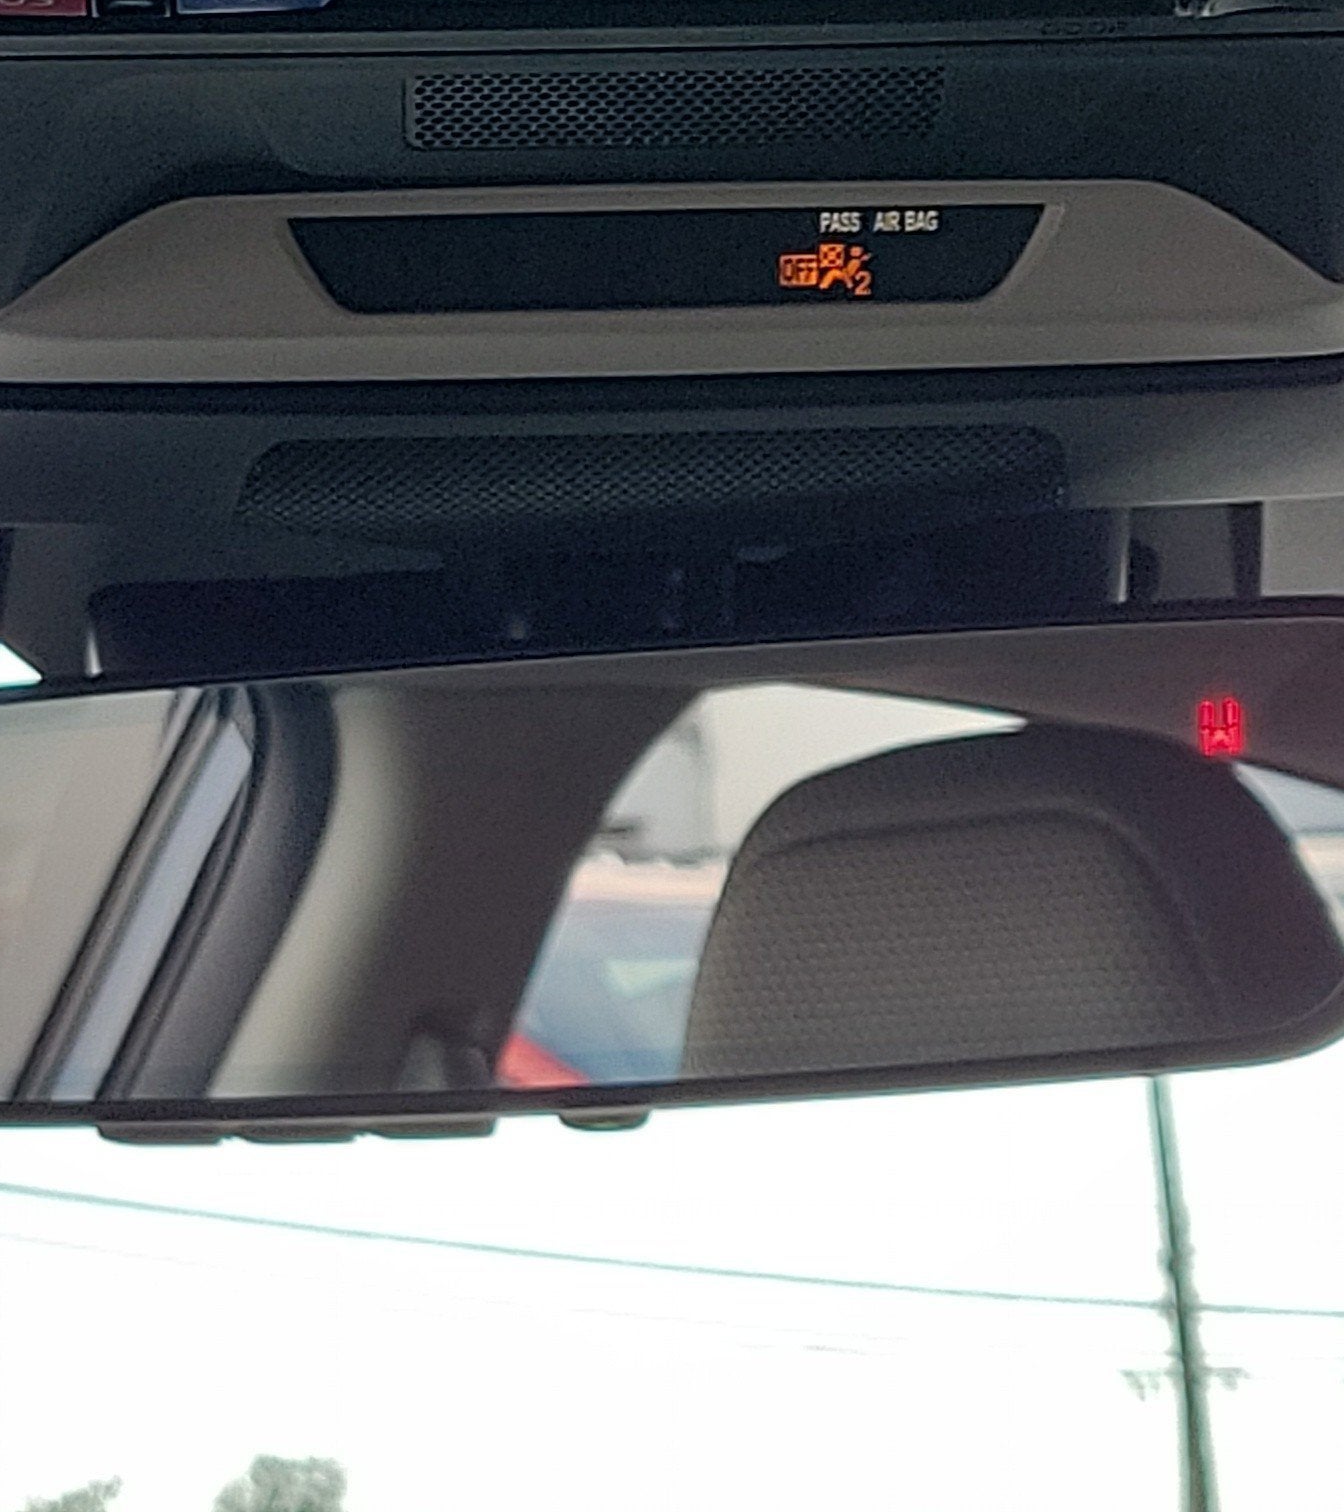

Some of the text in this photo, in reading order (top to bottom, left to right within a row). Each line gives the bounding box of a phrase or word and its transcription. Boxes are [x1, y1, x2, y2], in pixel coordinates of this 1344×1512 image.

[819, 210, 940, 233] PASS AIR BAG
[781, 257, 818, 285] OFF
[854, 270, 872, 296] 2
